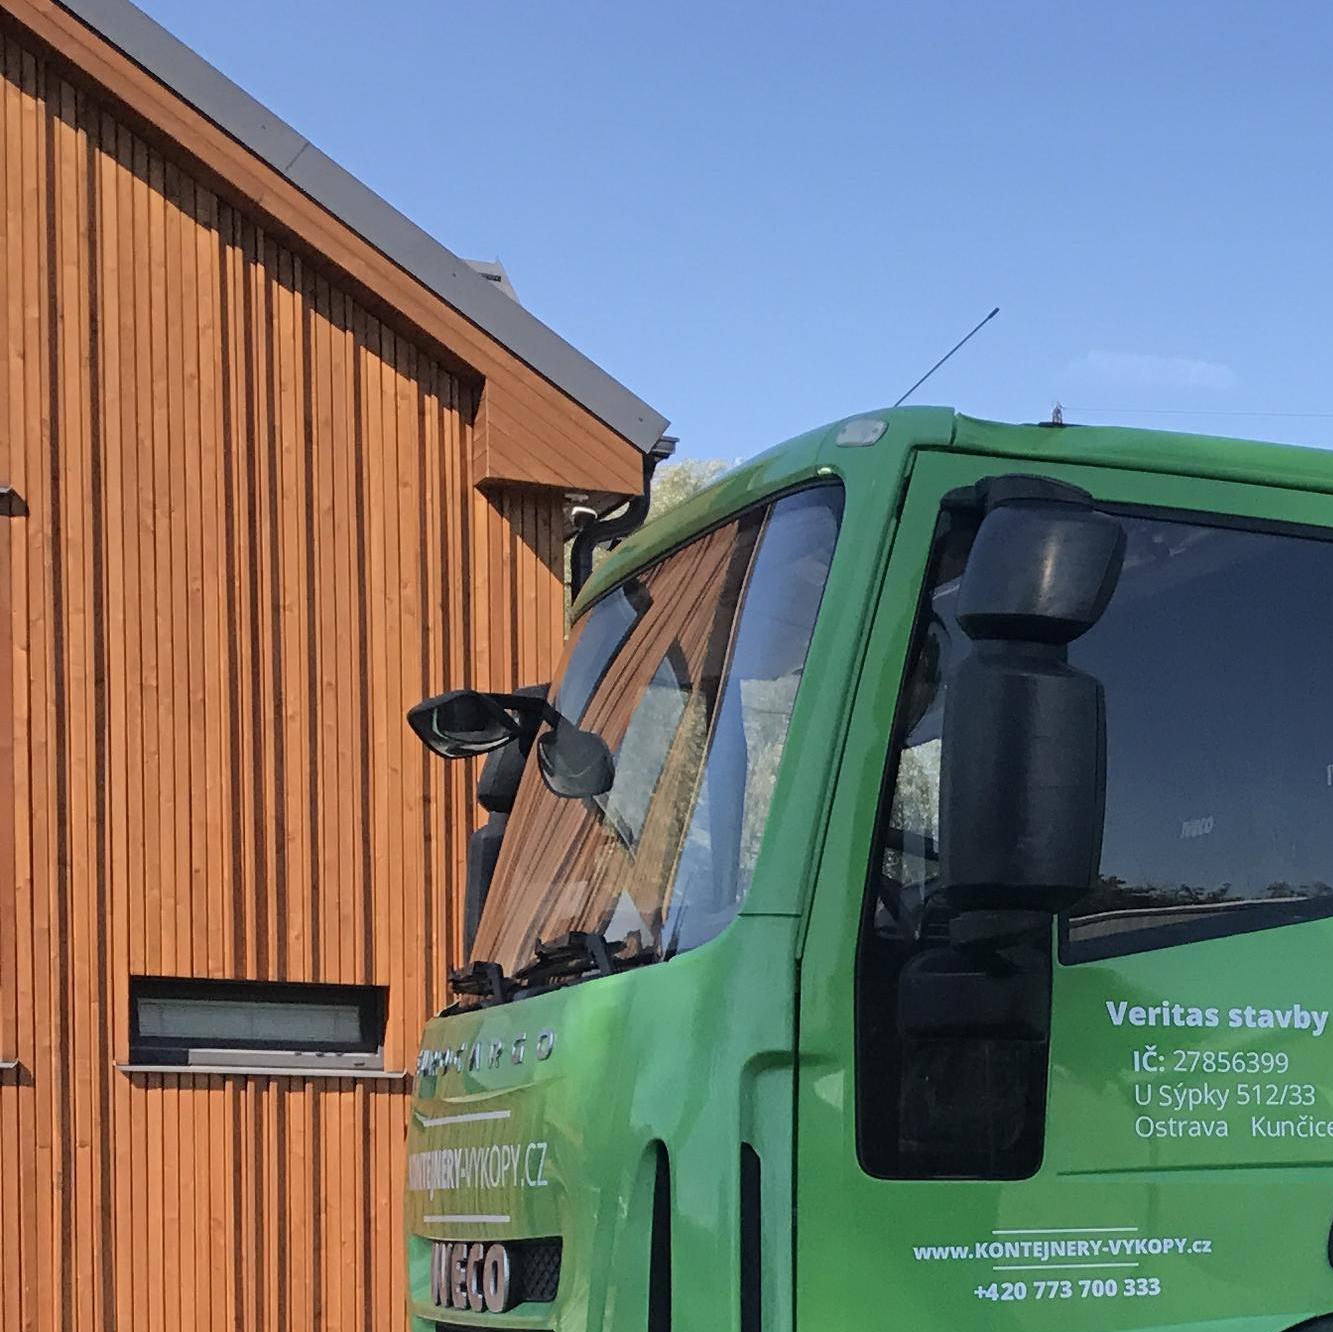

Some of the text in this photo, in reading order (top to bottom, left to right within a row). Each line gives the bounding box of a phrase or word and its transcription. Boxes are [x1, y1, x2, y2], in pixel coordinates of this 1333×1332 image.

[1106, 1000, 1220, 1027] Veritas
[1228, 1004, 1329, 1036] stavby
[417, 1028, 556, 1077] CARGO
[1133, 1044, 1290, 1074] IČ: 27856399
[1135, 1082, 1316, 1111] U Sýpky 512/33
[1135, 1116, 1229, 1138] Ostrava
[408, 1142, 549, 1201] TEJNERY-VYKOPY.CZ
[913, 1237, 1213, 1261] www.KONTEJNERY-VYKOPY.cz
[430, 1242, 510, 1313] IVECO
[974, 1278, 1162, 1301] +420 773 700 333
